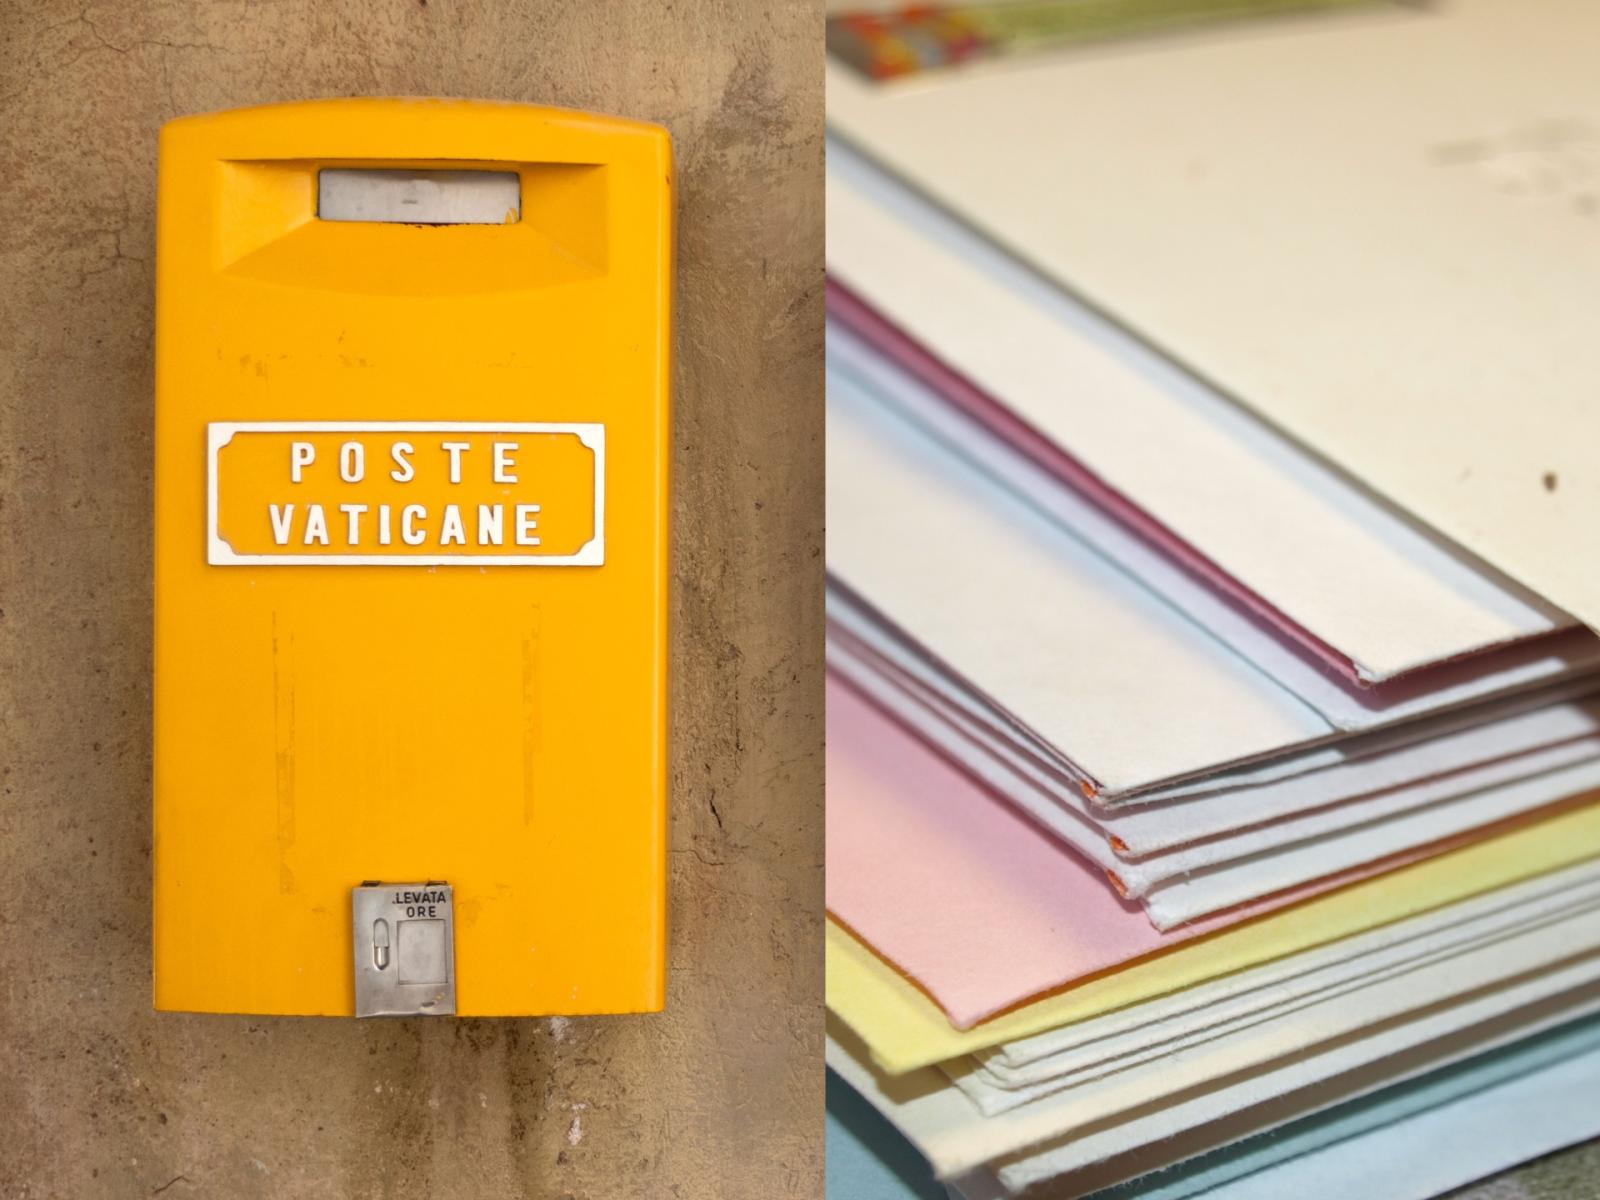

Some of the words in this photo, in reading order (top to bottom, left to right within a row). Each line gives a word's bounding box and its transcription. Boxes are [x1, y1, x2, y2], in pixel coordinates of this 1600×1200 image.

[291, 441, 519, 483] POSTE
[269, 504, 541, 545] VATICANE
[395, 891, 447, 904] LEVATA
[406, 906, 437, 918] ORE
